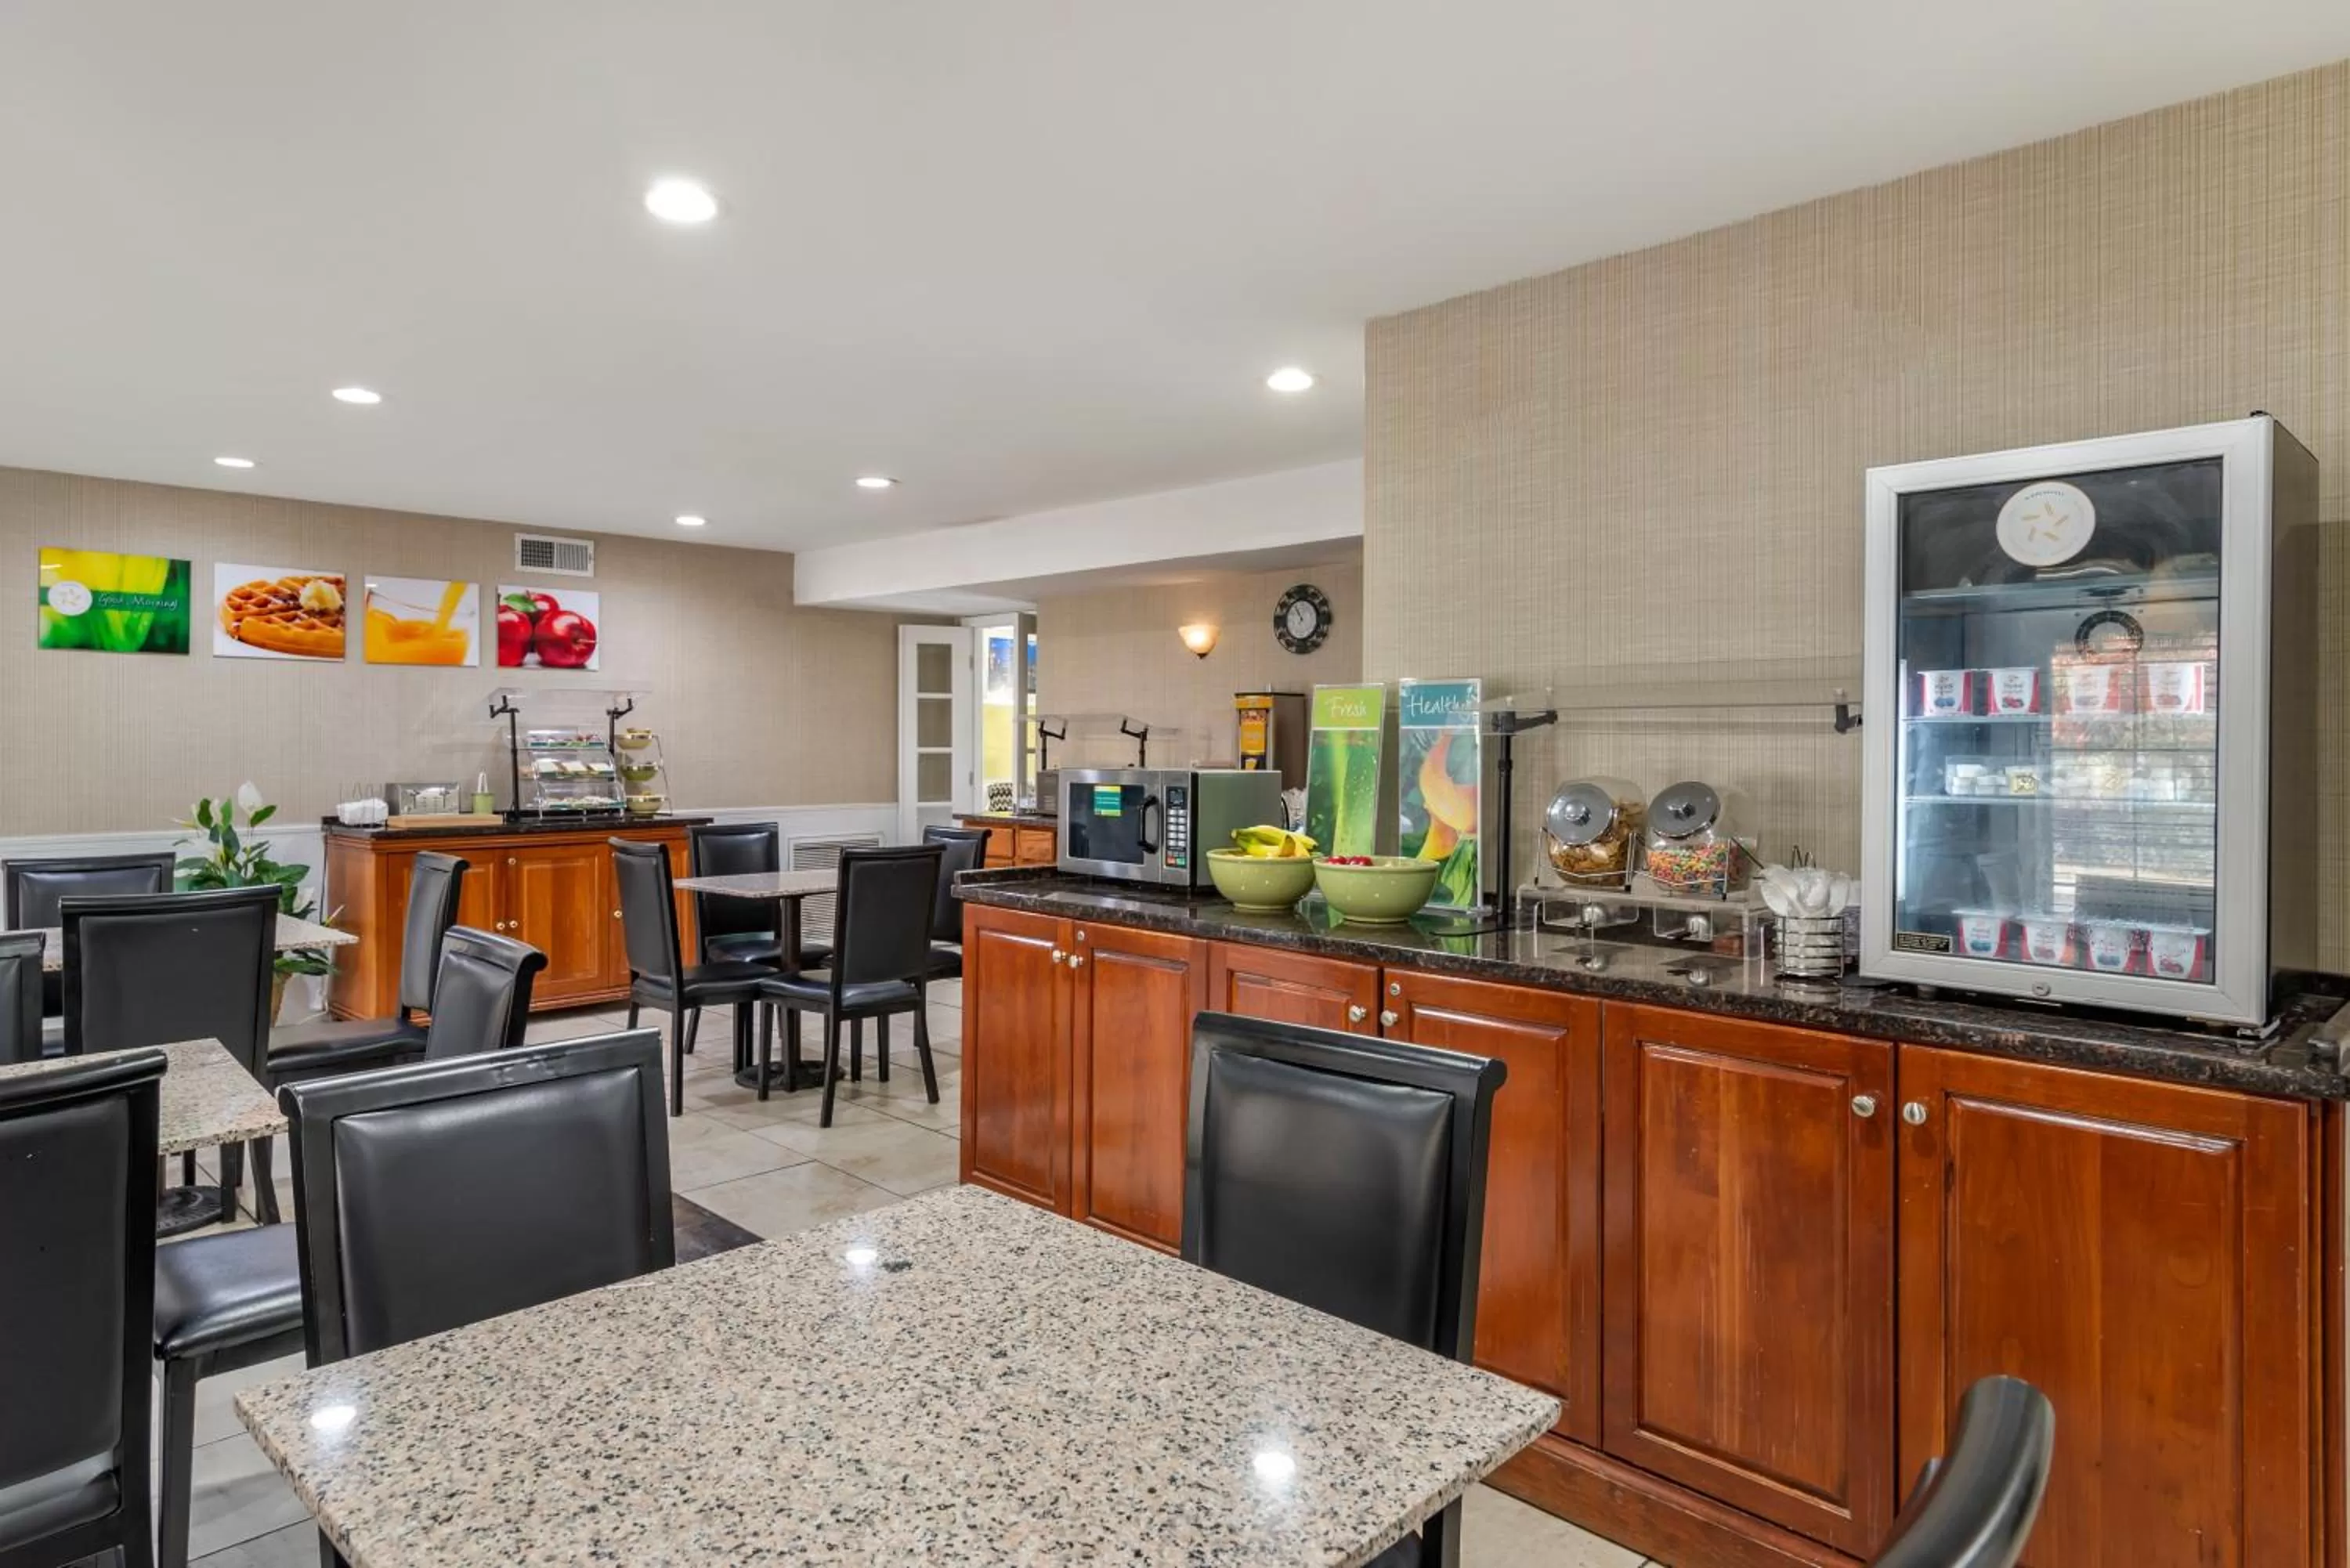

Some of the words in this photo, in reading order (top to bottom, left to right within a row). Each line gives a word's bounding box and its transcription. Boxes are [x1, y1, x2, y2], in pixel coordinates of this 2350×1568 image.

[98, 593, 123, 606] Good
[1330, 695, 1367, 718] Fresh
[1408, 694, 1474, 722] Healthy
